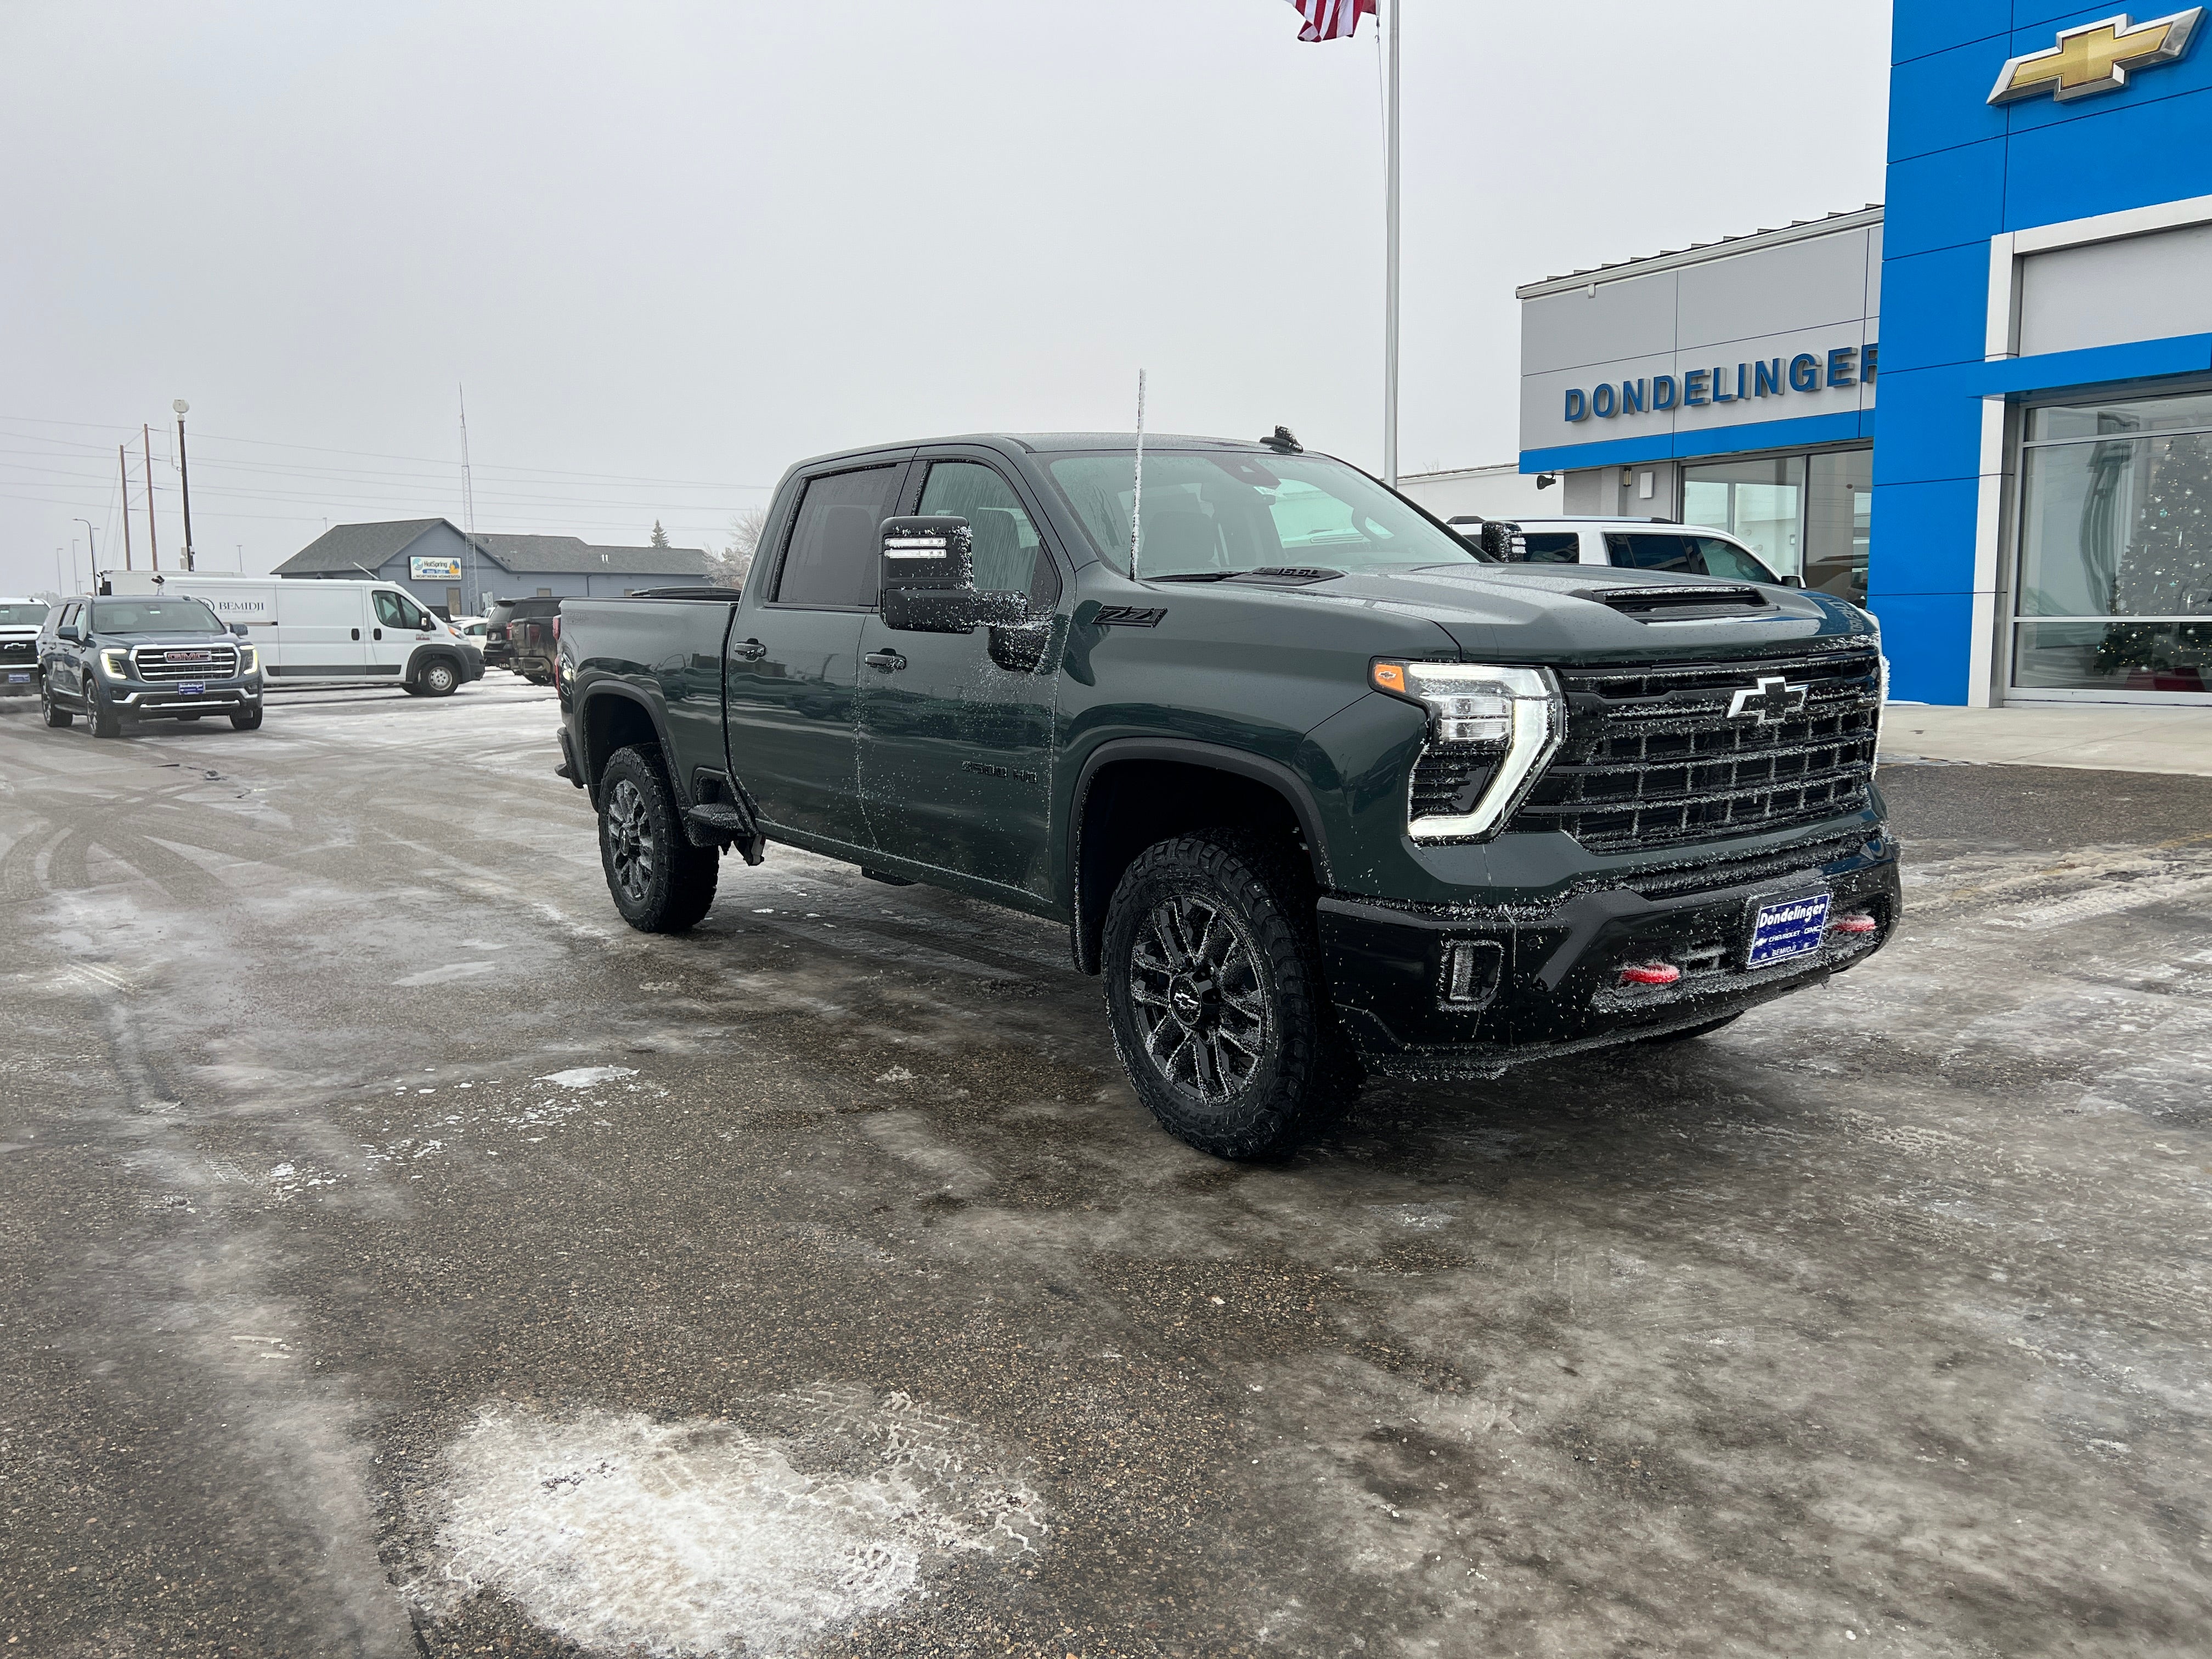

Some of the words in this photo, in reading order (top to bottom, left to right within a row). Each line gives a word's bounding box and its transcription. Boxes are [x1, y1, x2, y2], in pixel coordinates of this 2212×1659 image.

[1565, 342, 1879, 423] DONDELINGER
[424, 560, 448, 568] HotSpring
[219, 601, 264, 611] BEMIDJI
[1091, 604, 1169, 628] Z71
[167, 653, 209, 661] GMC
[1759, 903, 1825, 928] Dondelinger
[1768, 930, 1801, 943] CHEVROLET
[1804, 925, 1822, 934] GMC
[1771, 944, 1797, 956] BEMIDJI
